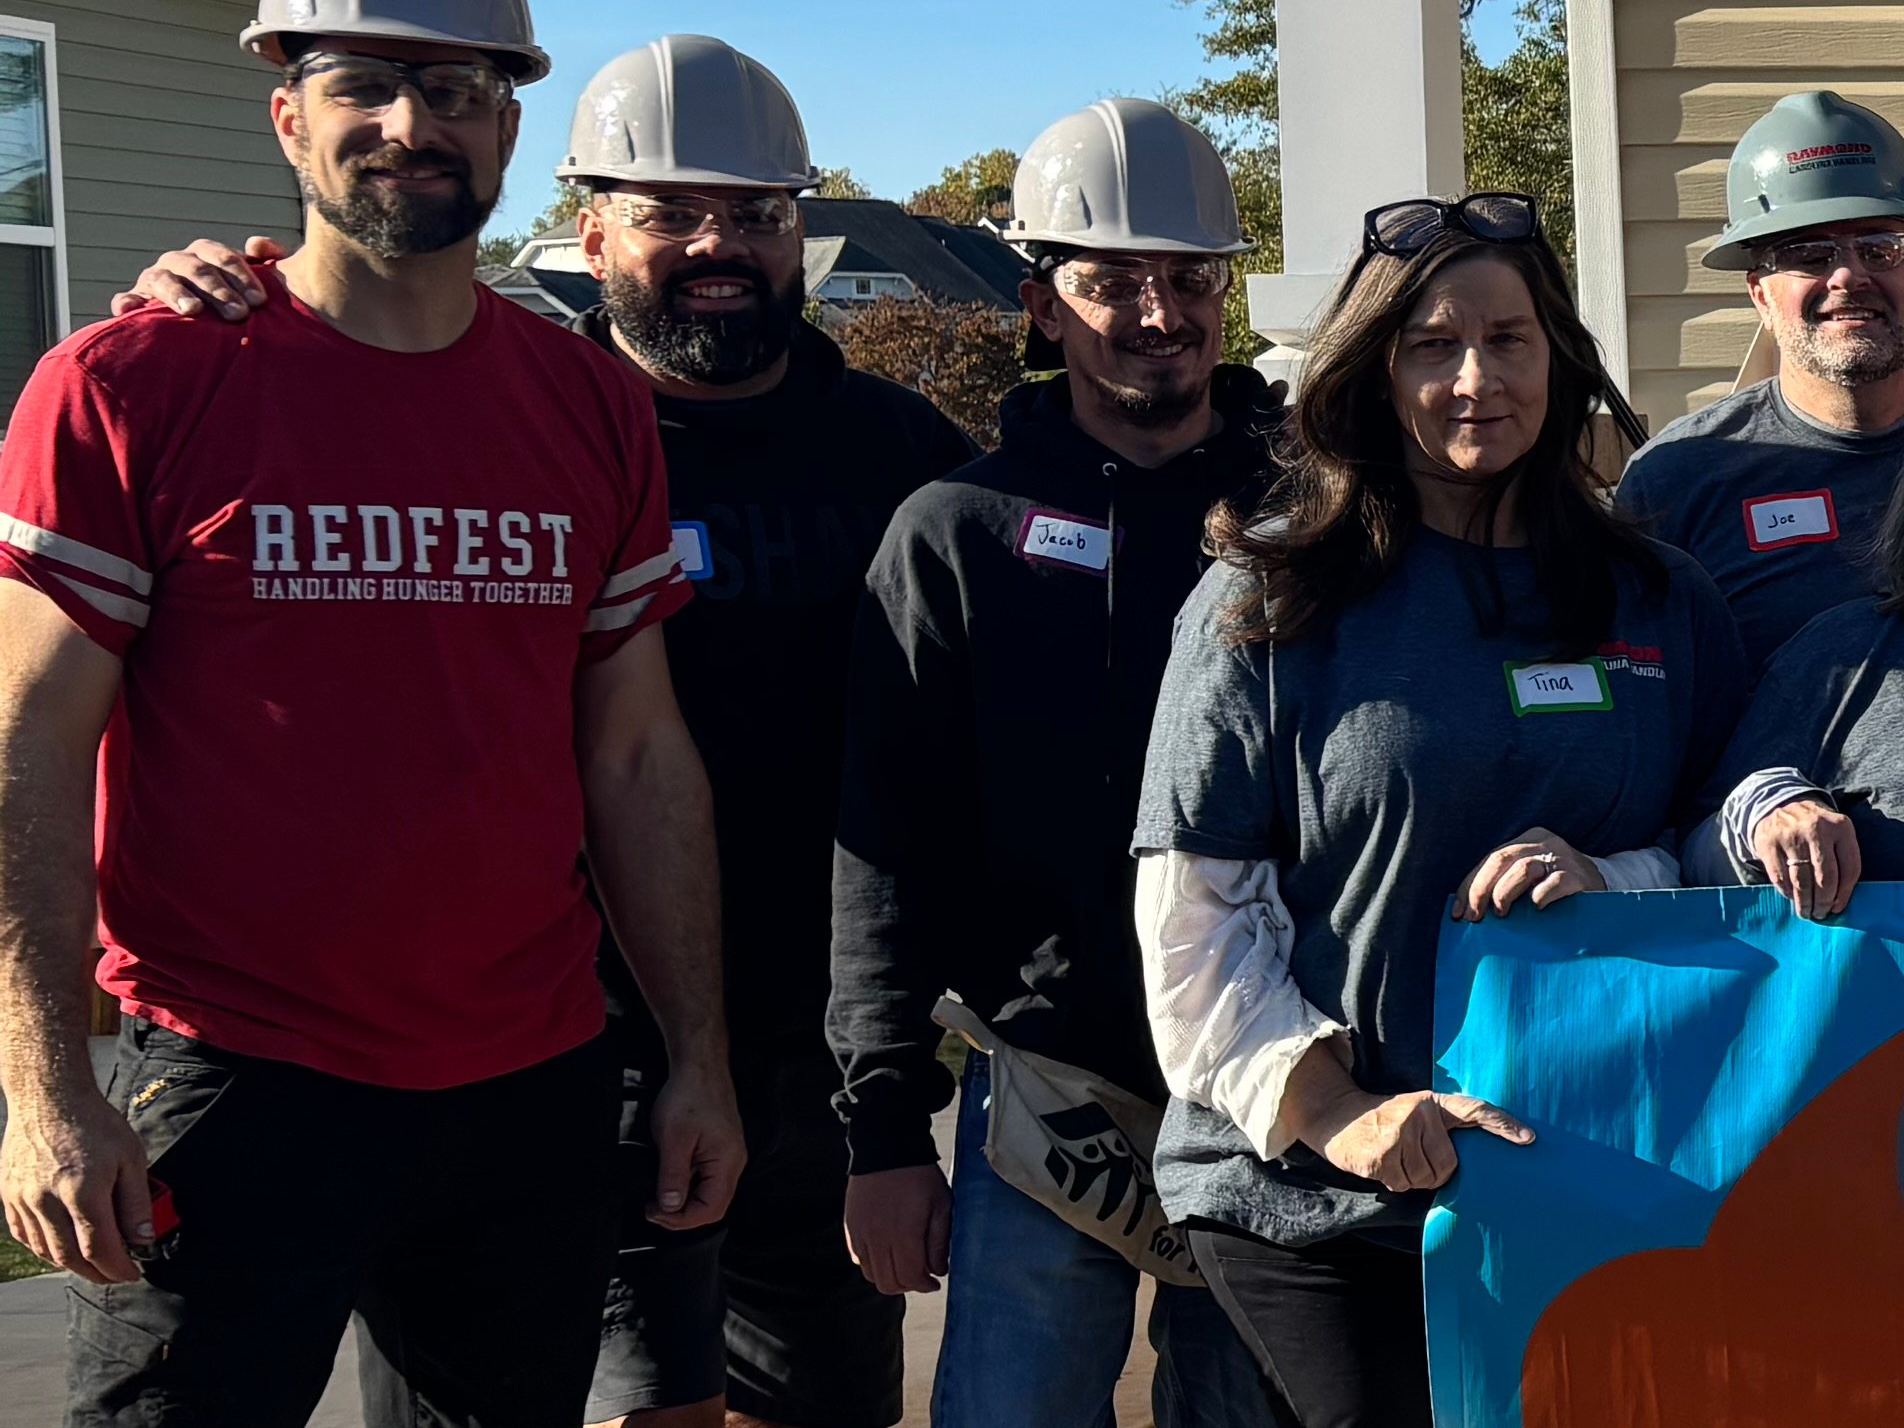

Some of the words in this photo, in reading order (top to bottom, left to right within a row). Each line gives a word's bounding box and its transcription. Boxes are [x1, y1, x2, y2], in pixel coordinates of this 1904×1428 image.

[1768, 514, 1796, 529] Joe
[251, 504, 573, 578] REDFEST
[1036, 522, 1086, 550] Jacob
[252, 577, 376, 600] HANDLING
[382, 579, 464, 603] HUNGER
[470, 581, 573, 605] TOGETHER
[1528, 672, 1574, 691] Tina
[1149, 1224, 1186, 1262] for
